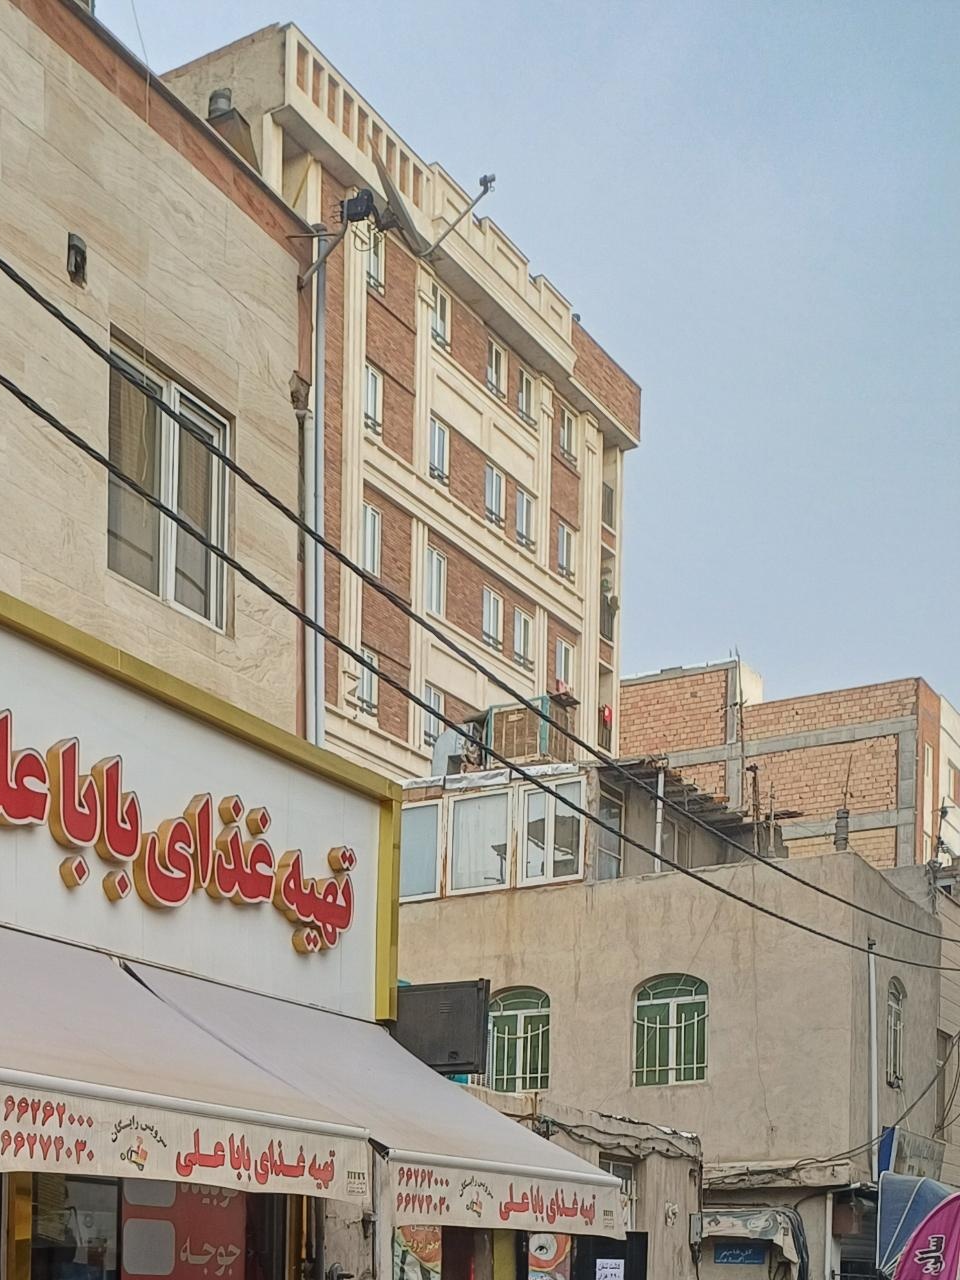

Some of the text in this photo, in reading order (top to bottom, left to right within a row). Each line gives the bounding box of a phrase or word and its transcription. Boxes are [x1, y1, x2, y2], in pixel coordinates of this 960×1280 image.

[50, 737, 141, 900] بابا
[140, 793, 275, 909] غذای
[277, 844, 357, 955] تهیه
[3, 1095, 93, 1129] ۶۶۲۶۲۰۰۰
[0, 1129, 94, 1165] ۶۶۲۷۴۰۳۰
[176, 1128, 226, 1177] علی
[228, 1133, 251, 1182] بابا
[254, 1138, 305, 1185] غذای
[308, 1150, 336, 1190] تهیه
[499, 1182, 529, 1222] علی
[529, 1184, 544, 1223] بابا
[546, 1187, 579, 1225] غذای
[180, 1236, 240, 1276] جوجه
